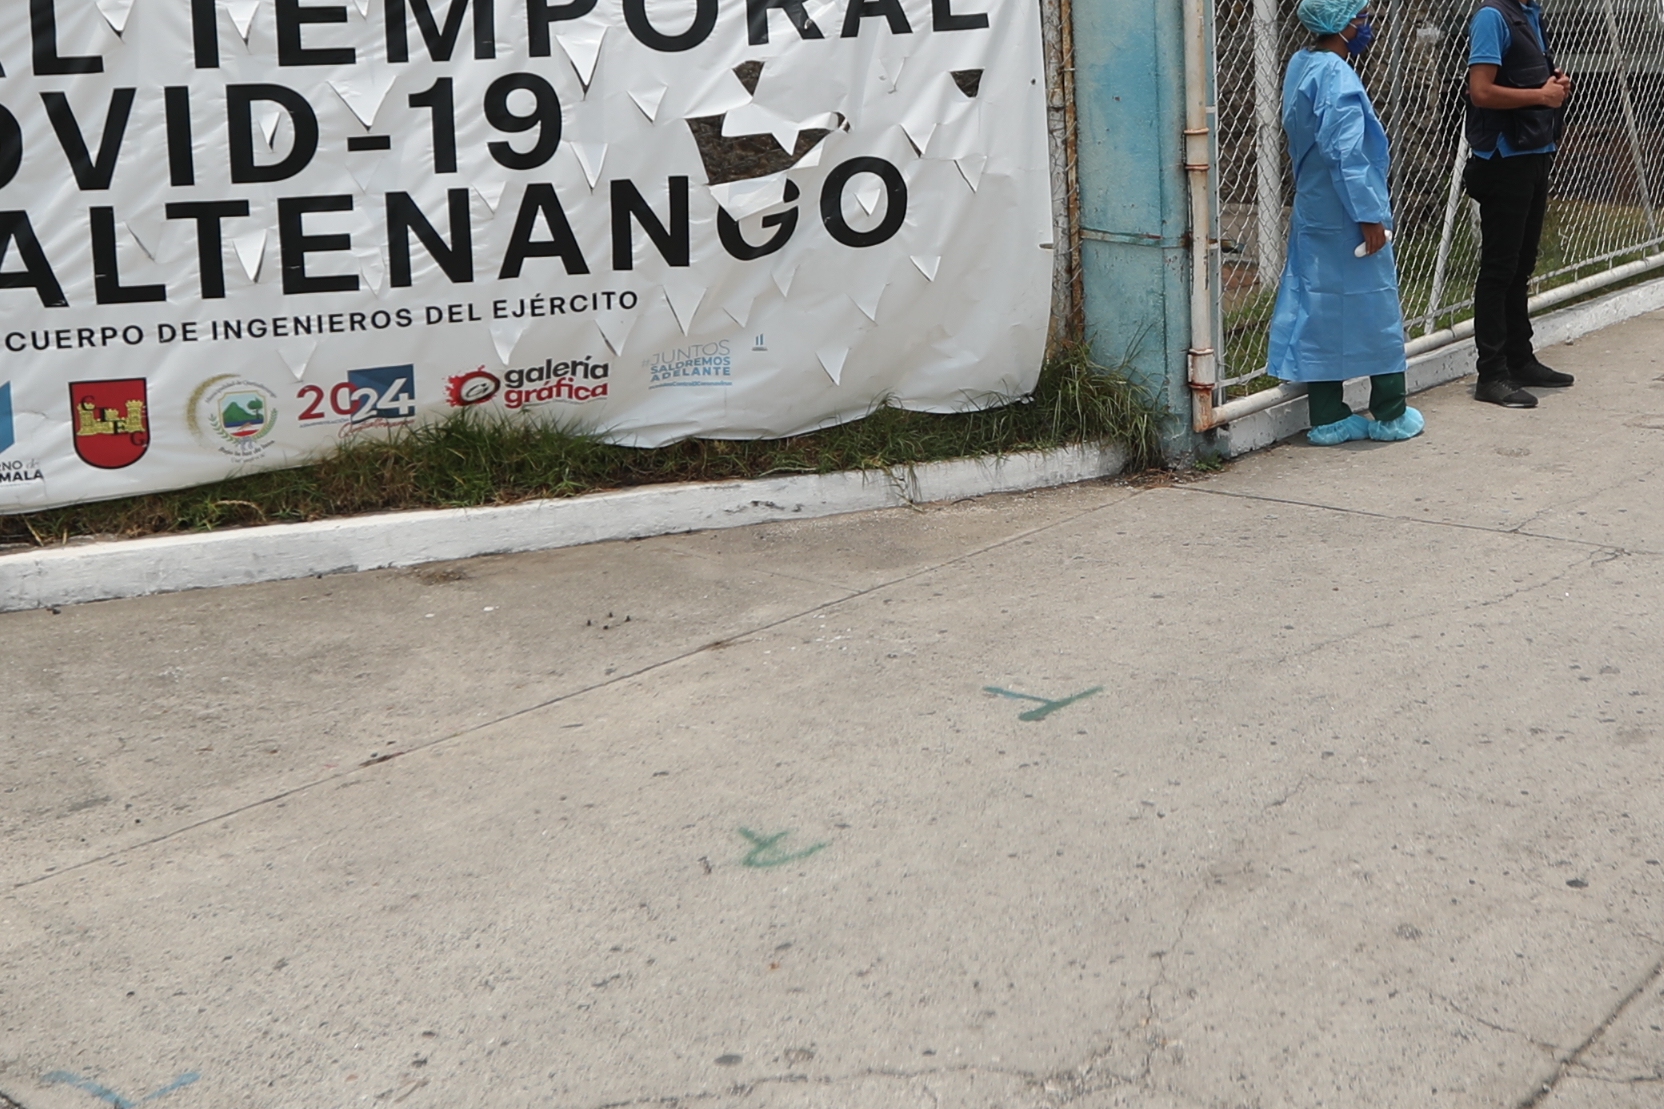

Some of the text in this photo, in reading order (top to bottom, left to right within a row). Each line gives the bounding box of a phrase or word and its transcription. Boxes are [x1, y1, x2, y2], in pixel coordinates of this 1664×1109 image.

[0, 71, 563, 191] VID-19
[0, 156, 909, 308] ALTENANGO
[5, 291, 638, 352] CUERPO DE INGENIEROS DEL EJÉRCITO
[641, 339, 731, 368] #JUNTOS
[650, 356, 731, 375] SALDREMOS
[504, 355, 609, 389] galería
[650, 366, 731, 383] ADELANTE
[296, 377, 415, 424] 2024
[504, 377, 608, 409] gráfica
[0, 460, 23, 471] NO
